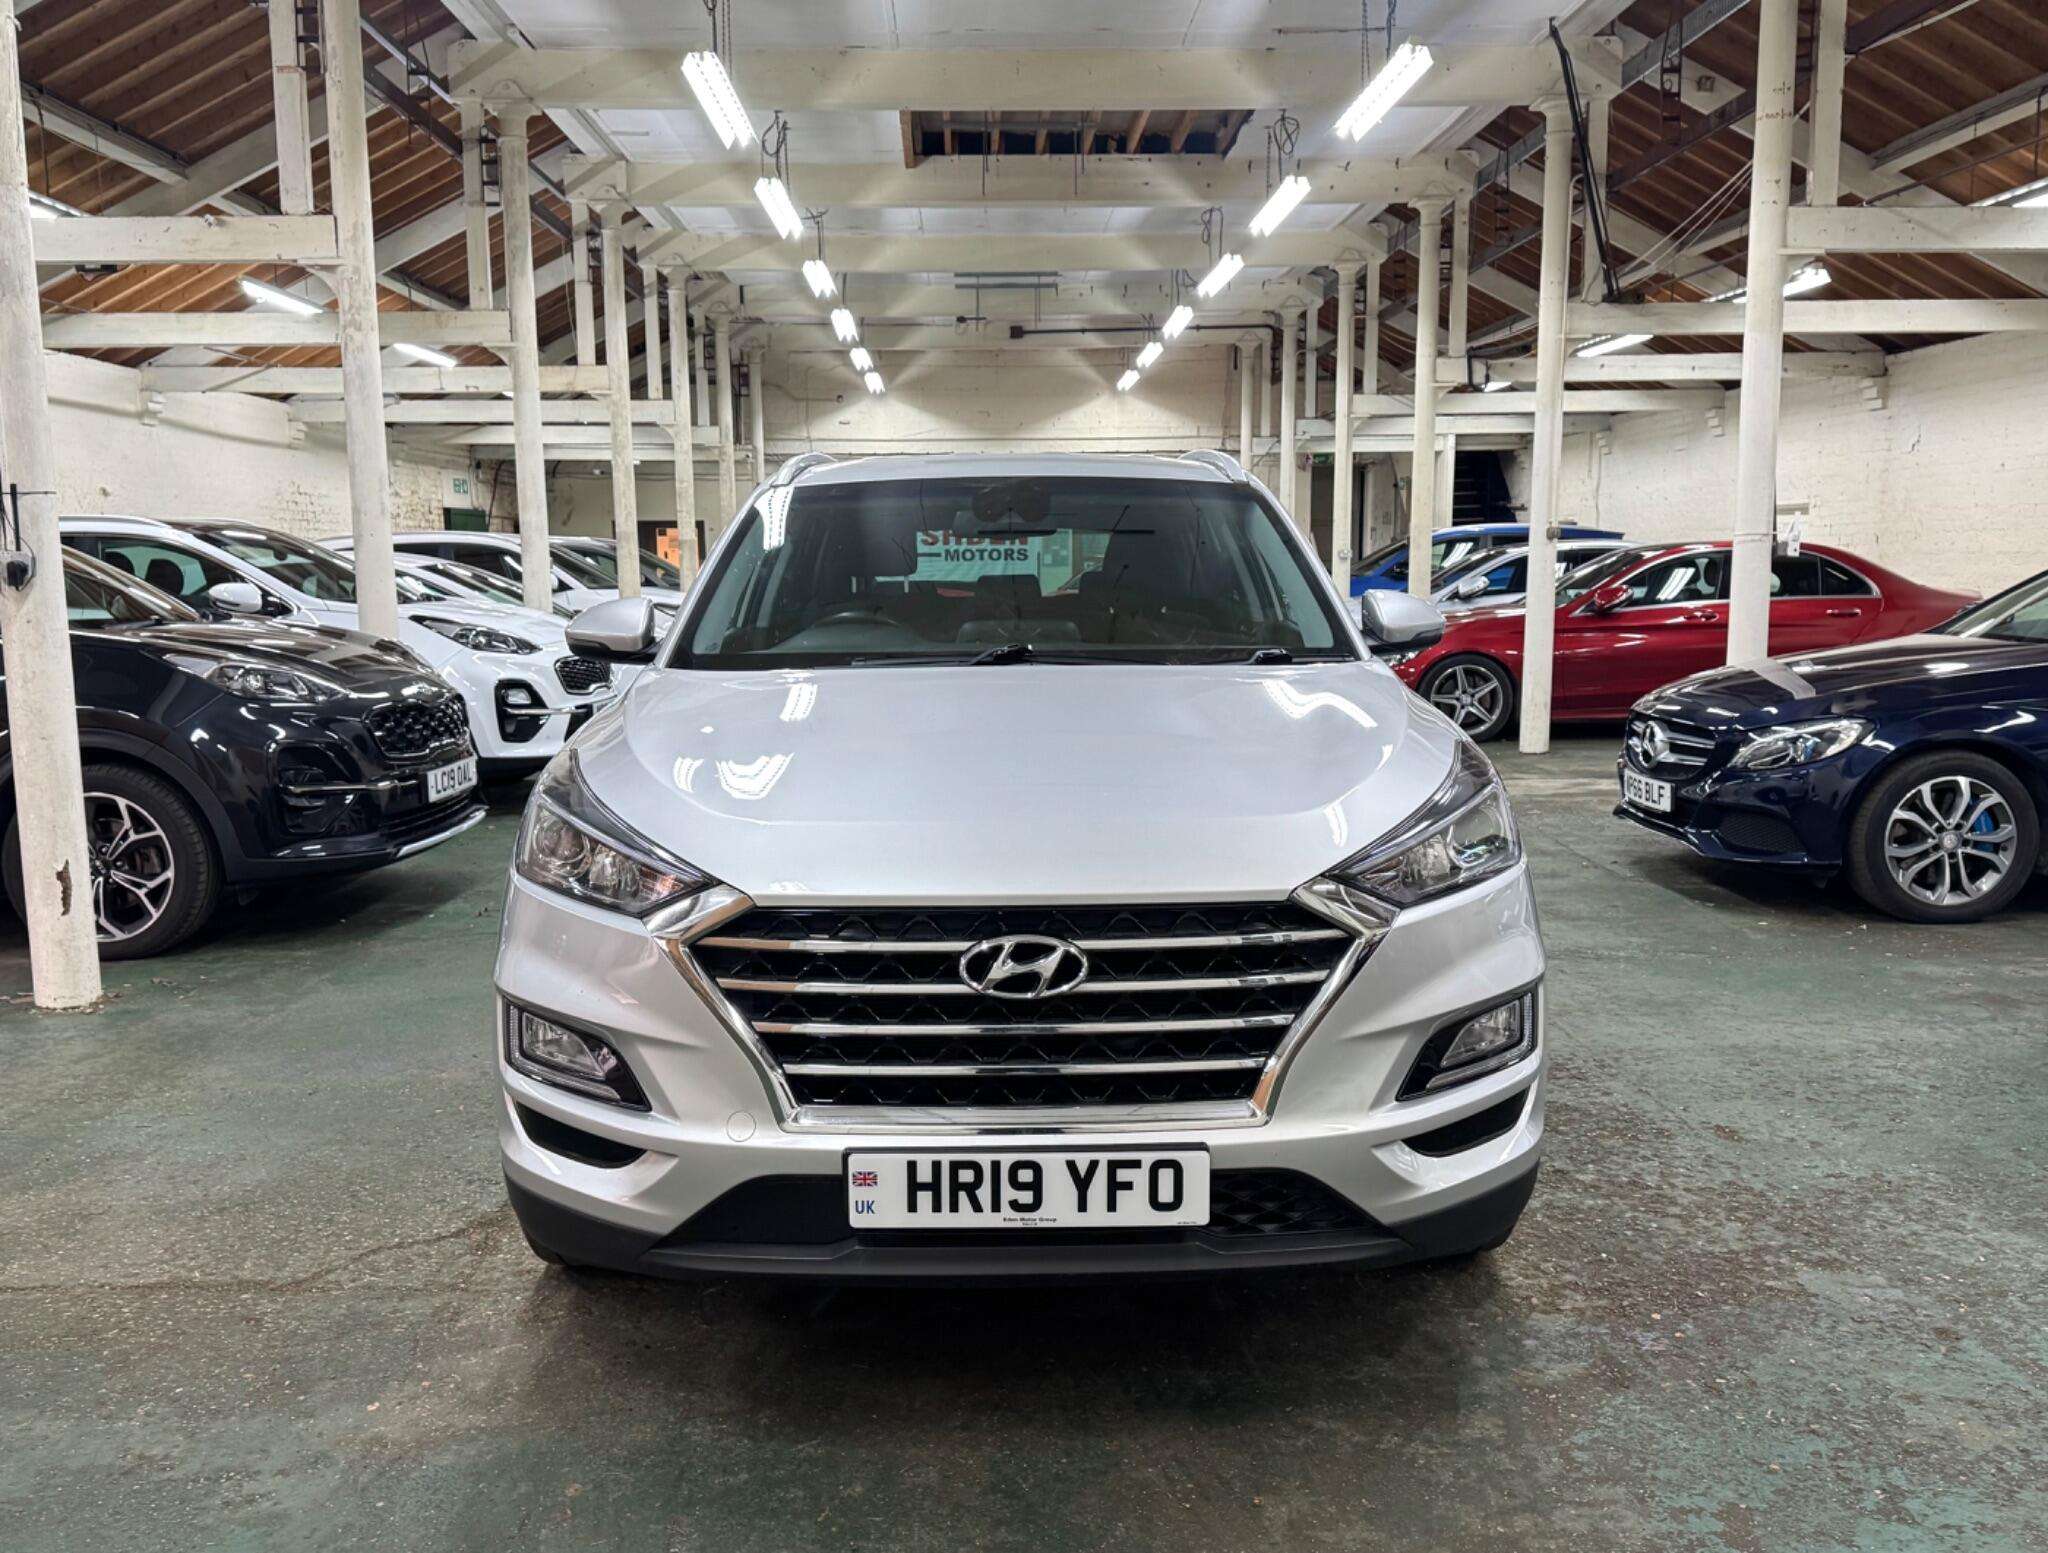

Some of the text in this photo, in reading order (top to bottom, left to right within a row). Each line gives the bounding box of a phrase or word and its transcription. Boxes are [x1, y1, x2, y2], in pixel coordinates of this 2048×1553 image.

[944, 548, 1029, 562] MOTORS
[434, 768, 455, 794] LC19
[1645, 781, 1665, 806] BLF
[906, 1158, 1184, 1213] HR19 YFO
[855, 1200, 875, 1215] UK
